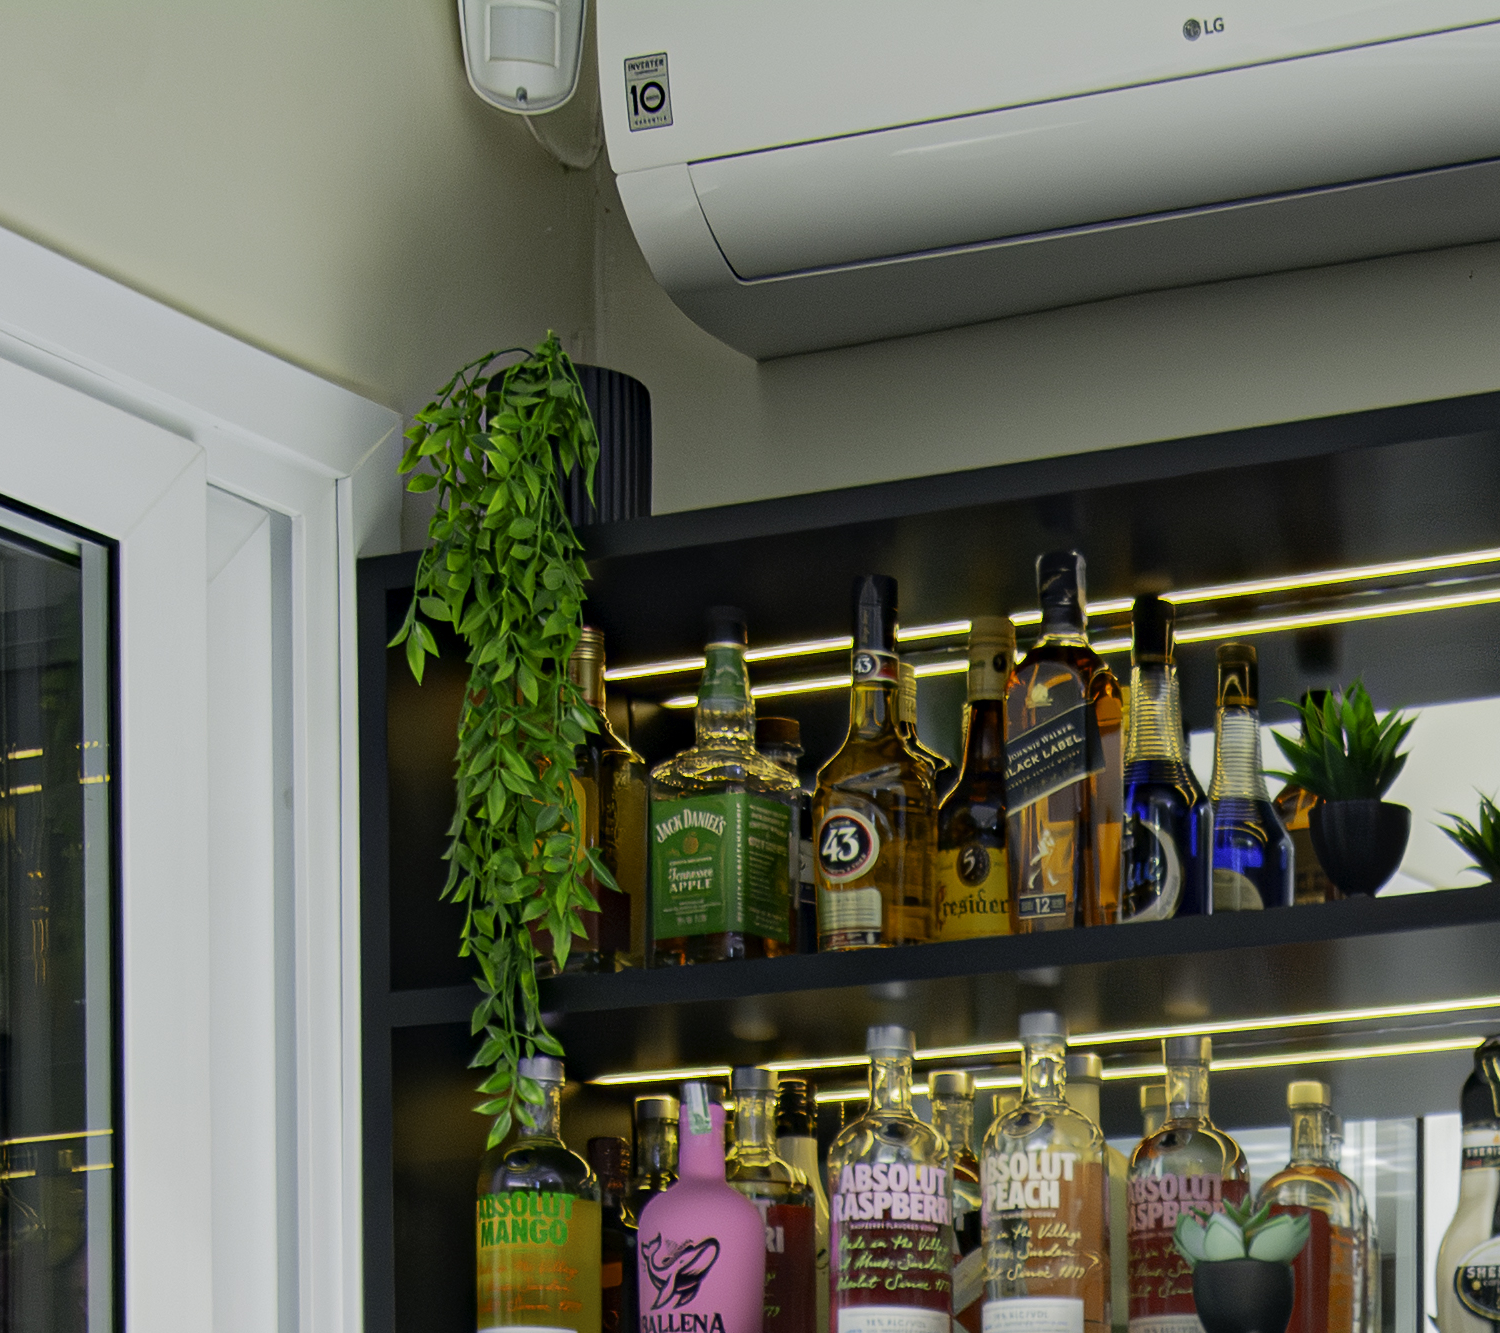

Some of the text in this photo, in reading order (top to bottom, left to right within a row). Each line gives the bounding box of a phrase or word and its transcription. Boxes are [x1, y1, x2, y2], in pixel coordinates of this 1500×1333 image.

[1203, 17, 1225, 35] LG
[627, 58, 665, 72] INVERTER
[630, 81, 666, 115] 10
[854, 655, 873, 674] 43
[1042, 734, 1083, 759] LABEL
[655, 808, 727, 843] JACK DANIEL'S
[821, 826, 860, 863] 43
[669, 878, 713, 893] APPLE
[1034, 897, 1051, 914] 12
[840, 1162, 947, 1196] ABSOLUT
[979, 1152, 1076, 1184] ABSOLUT
[478, 1191, 576, 1222] ABSOLUT
[833, 1191, 952, 1226] RASPBERR
[986, 1180, 1060, 1212] PEACH
[480, 1217, 569, 1248] MANGO
